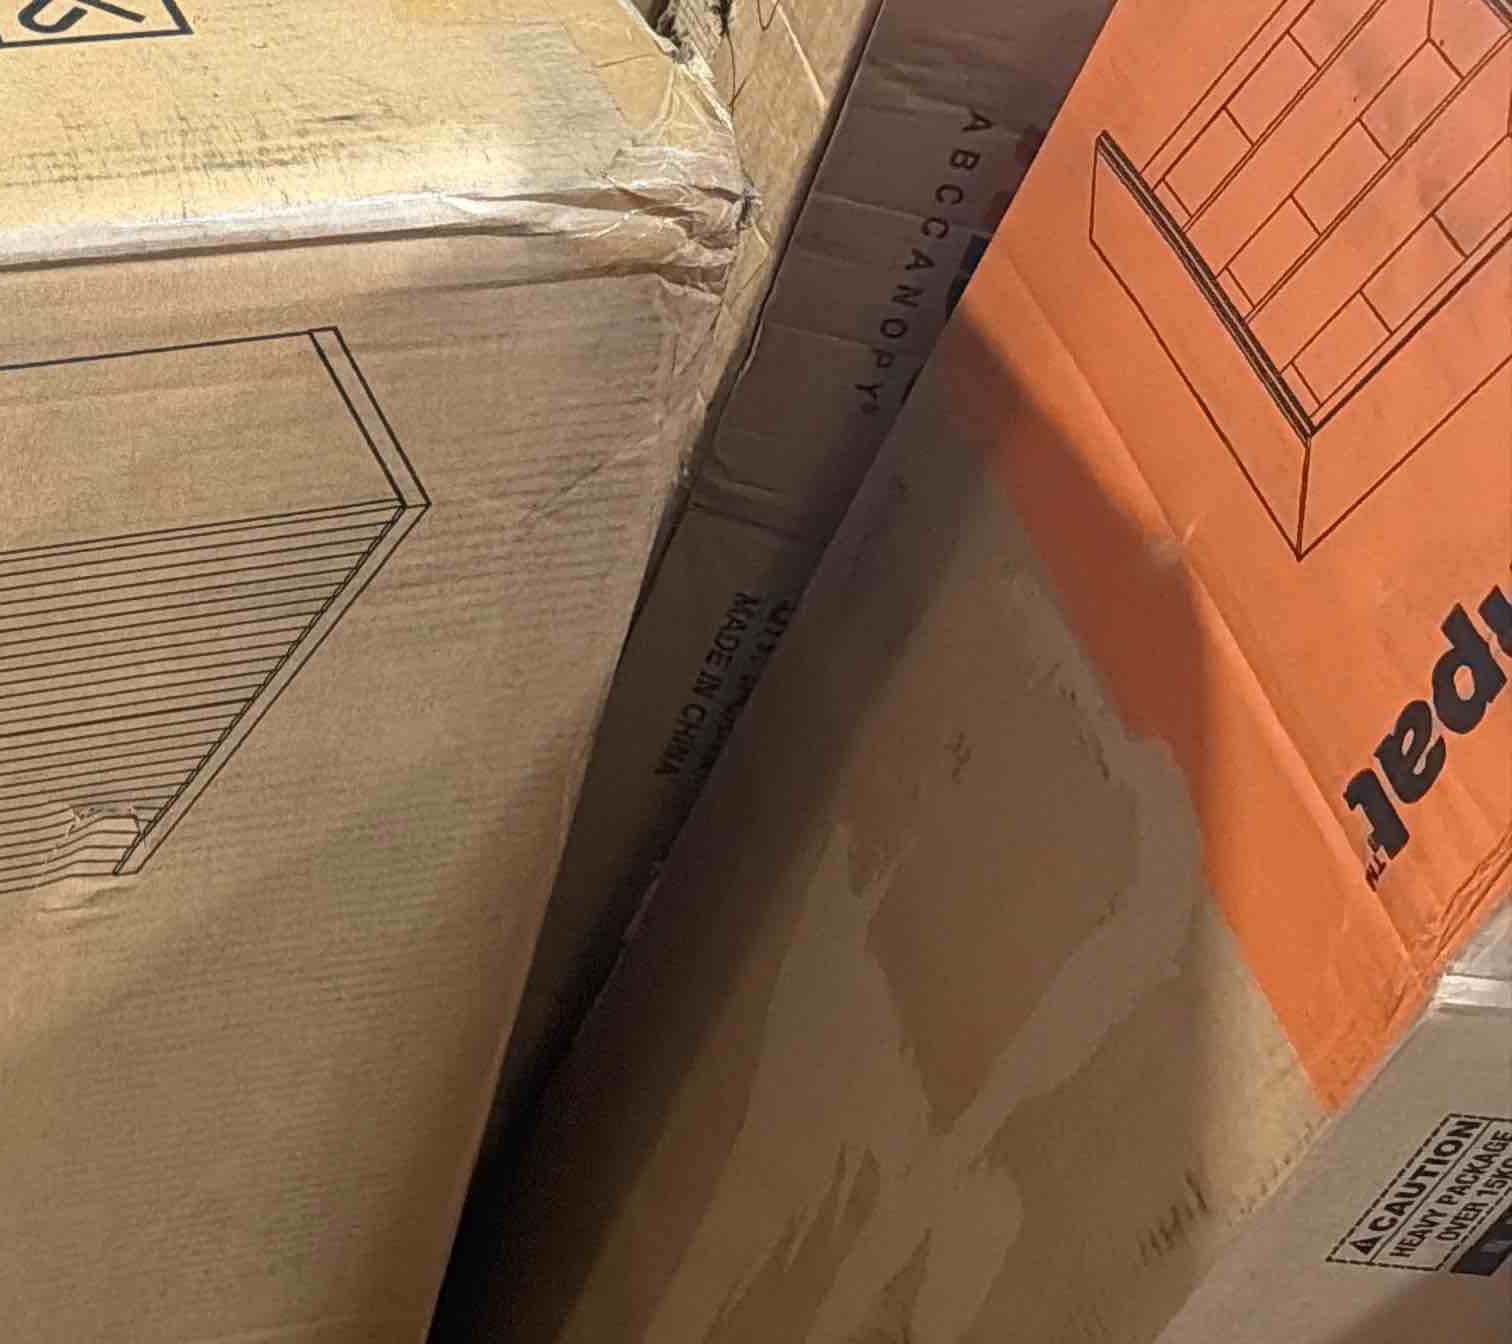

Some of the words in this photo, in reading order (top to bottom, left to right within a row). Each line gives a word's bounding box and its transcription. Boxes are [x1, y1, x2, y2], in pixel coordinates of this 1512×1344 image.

[1368, 1119, 1483, 1232] CAUTION
[1389, 1208, 1448, 1258] HEAVY
[1435, 1130, 1512, 1206] PACKAGE
[1435, 1201, 1489, 1242] OVER
